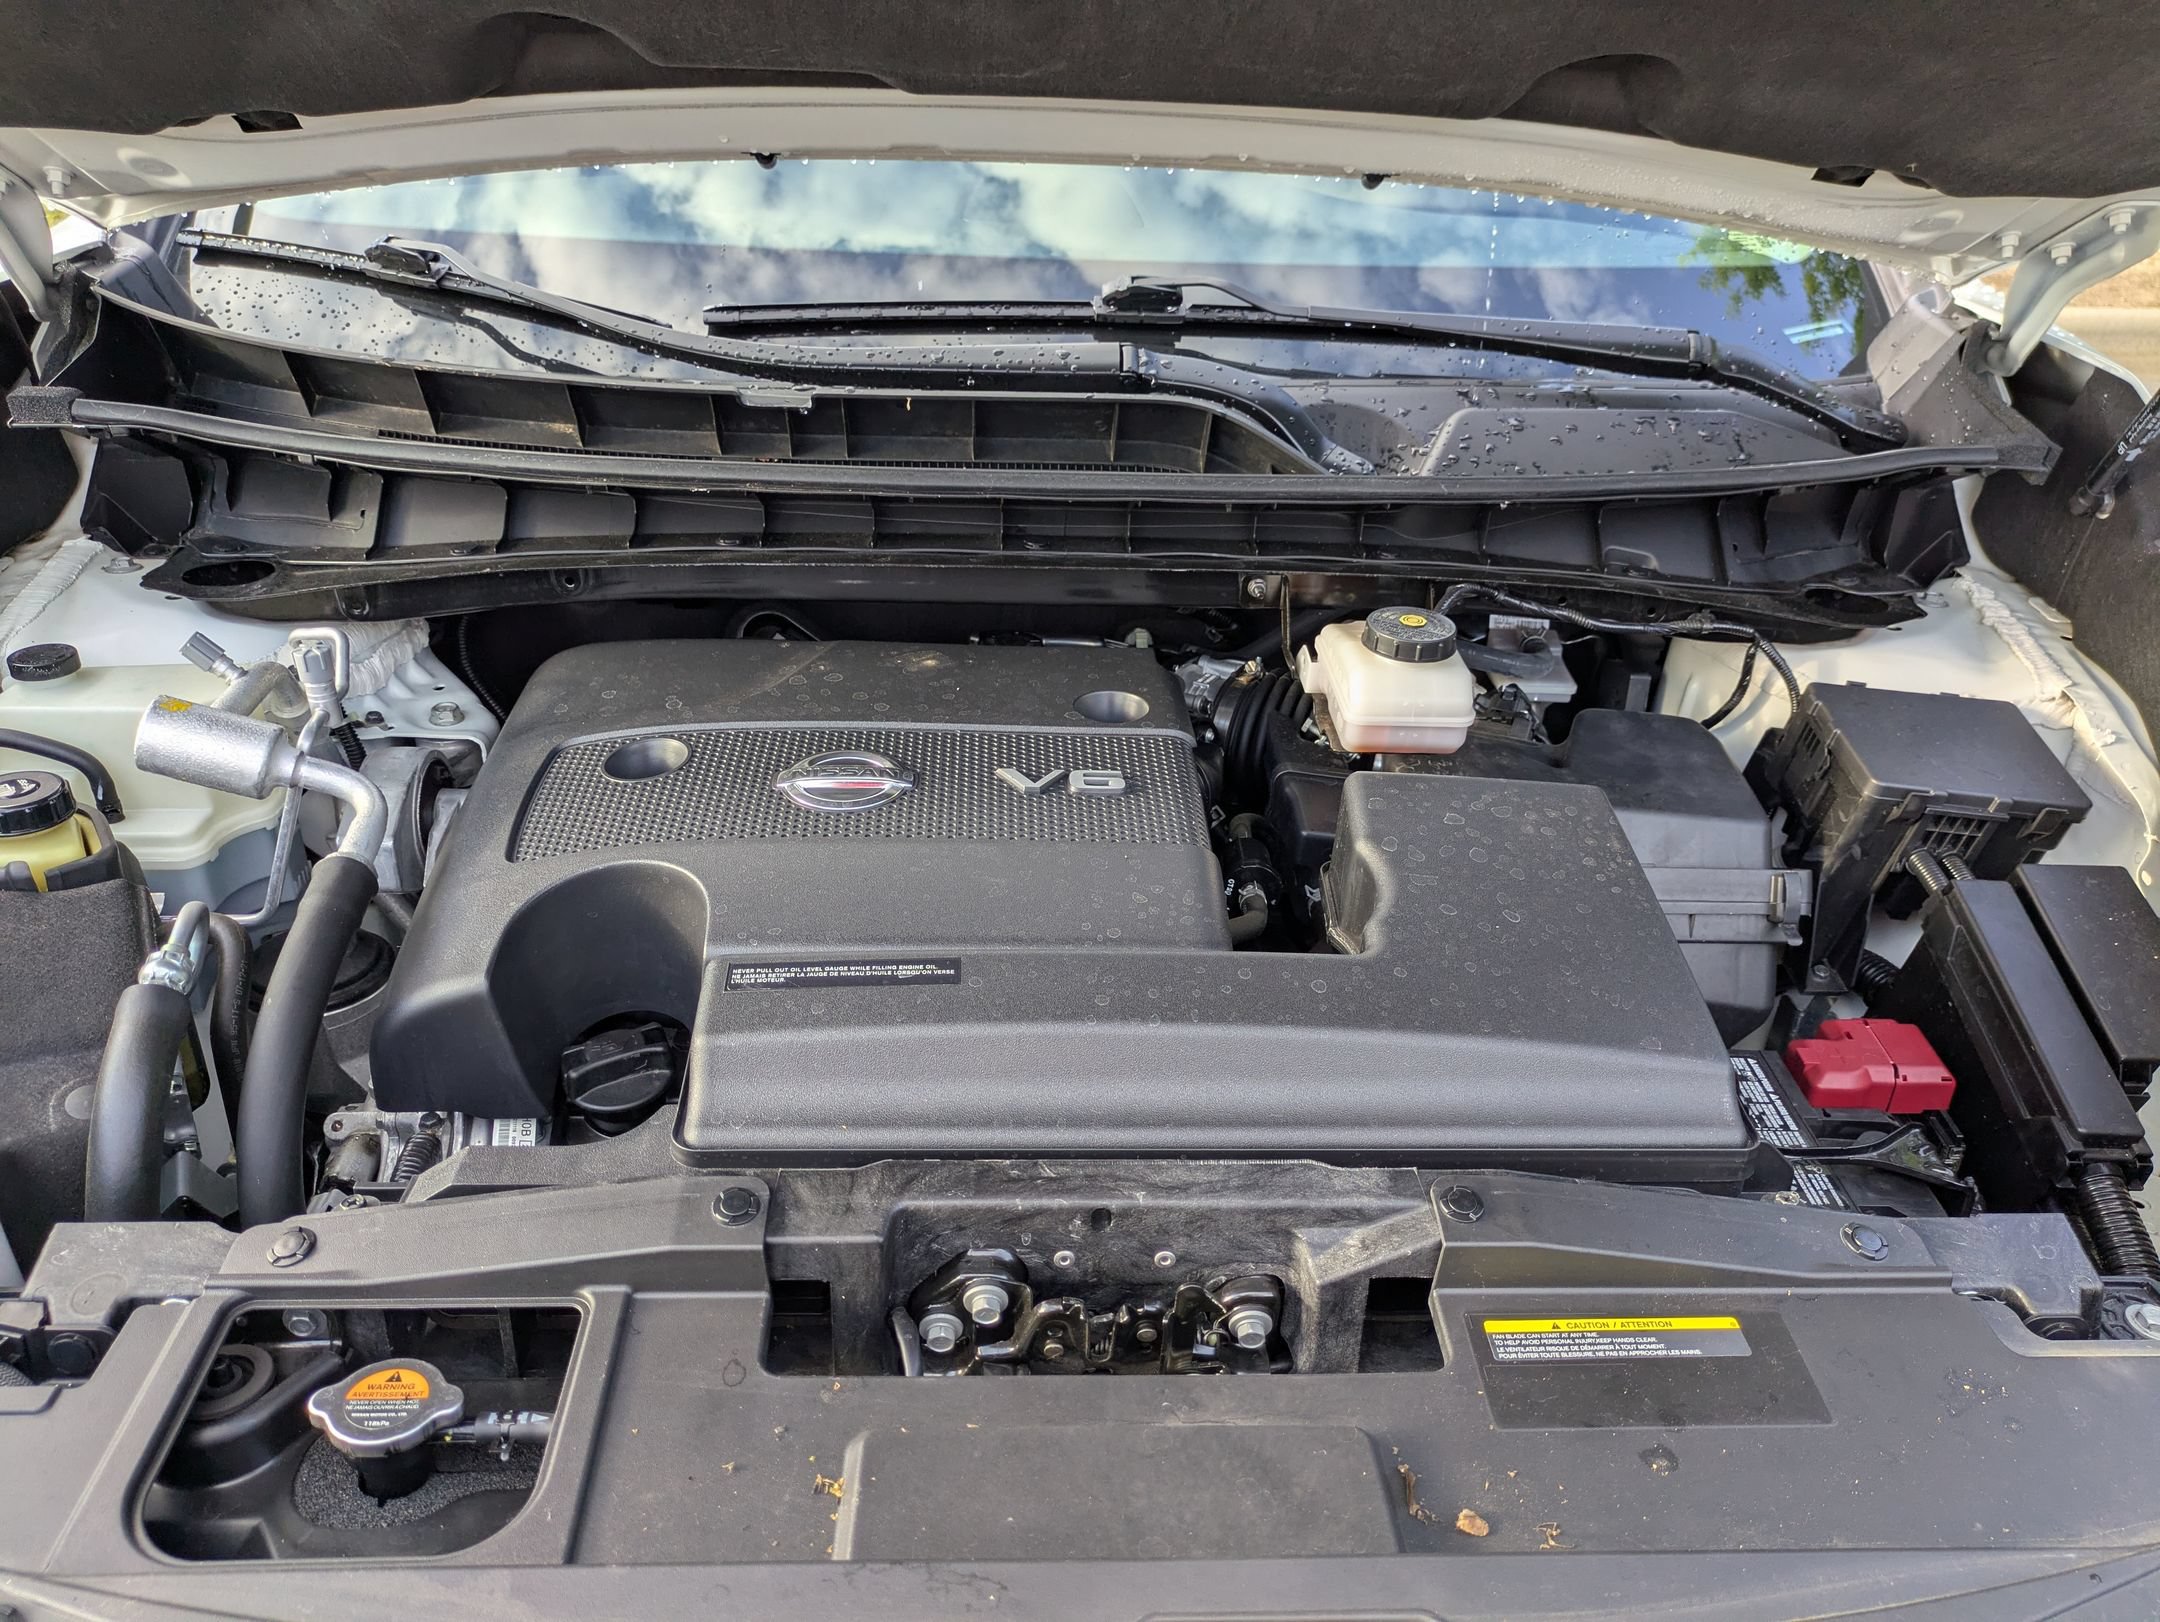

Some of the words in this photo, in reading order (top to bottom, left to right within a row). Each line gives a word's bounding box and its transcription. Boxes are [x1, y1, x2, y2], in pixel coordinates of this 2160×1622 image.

[2117, 441, 2128, 455] UP
[788, 766, 900, 778] NISSAN
[994, 768, 1125, 793] V6
[1566, 1320, 1610, 1329] CAUTION
[1620, 1320, 1673, 1329] ATTENTION
[367, 1383, 416, 1391] WARNING
[351, 1390, 426, 1398] AVERTISSEMENT
